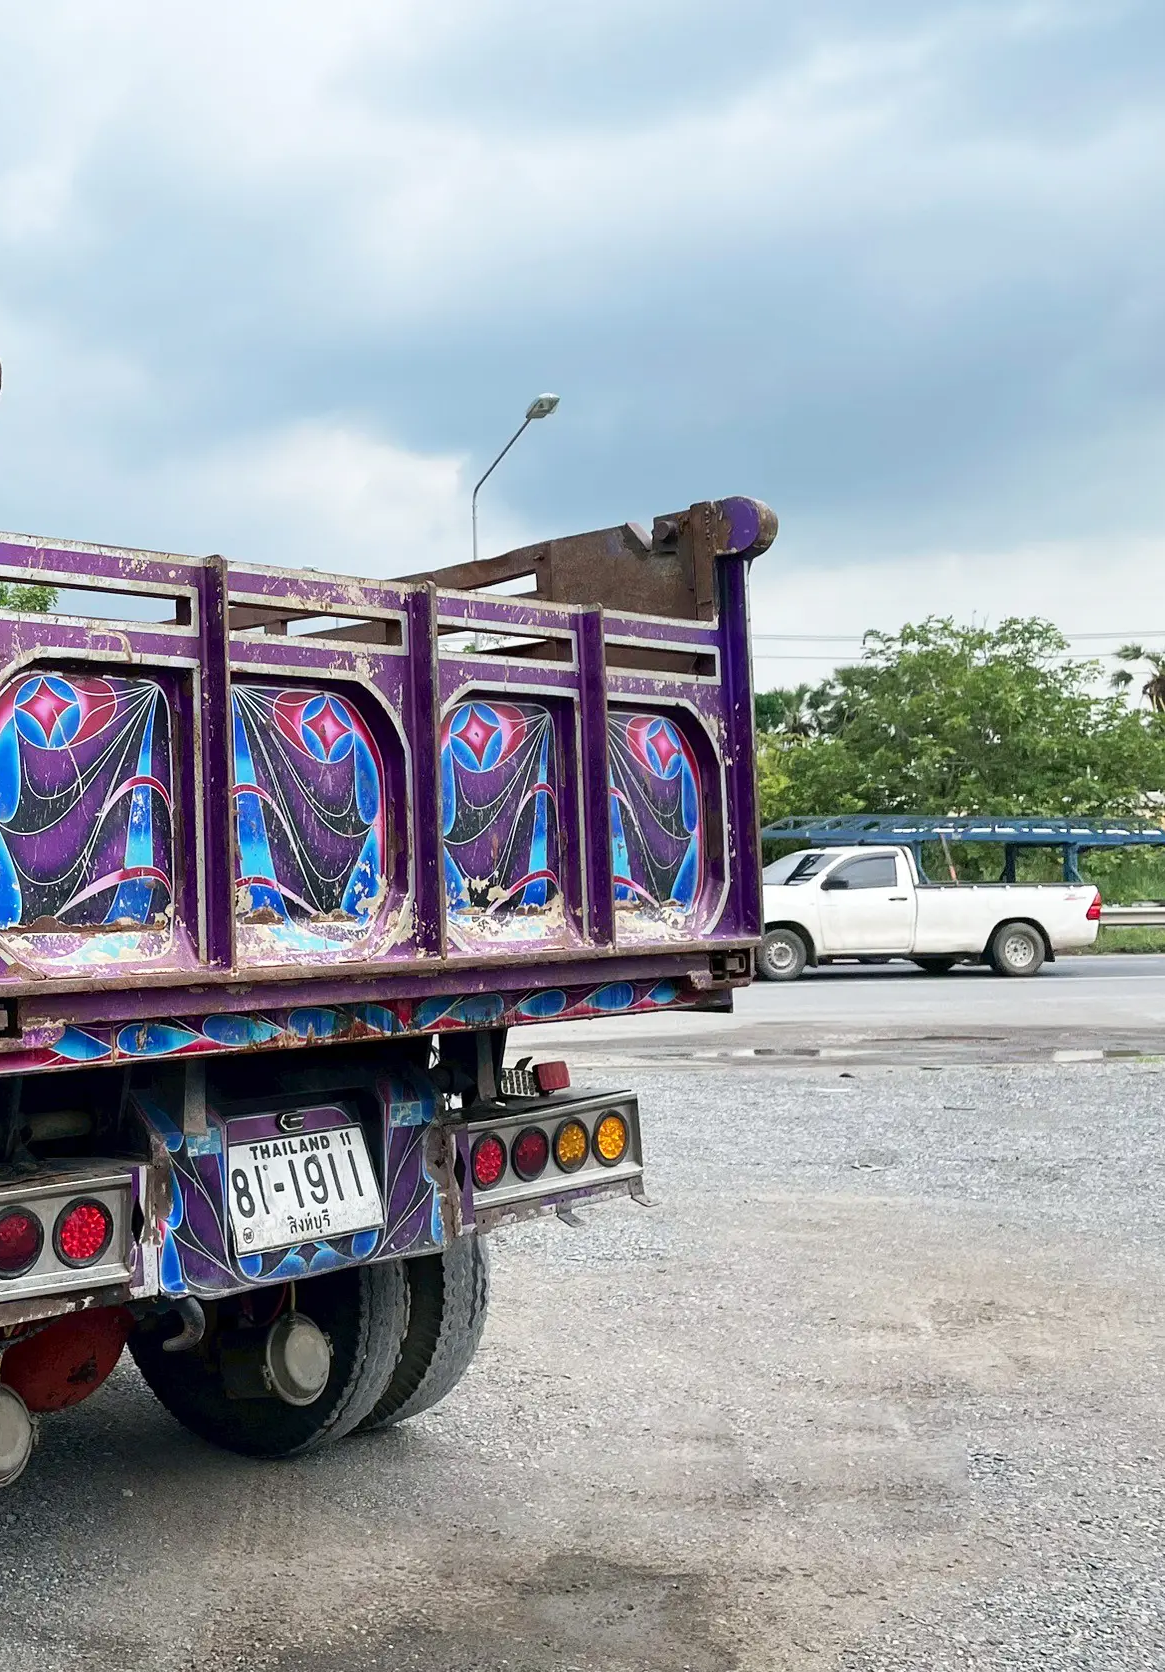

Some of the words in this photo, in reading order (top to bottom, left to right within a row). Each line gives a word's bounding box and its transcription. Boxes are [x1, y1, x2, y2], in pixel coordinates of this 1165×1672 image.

[250, 1135, 331, 1161] THAILAND
[231, 1149, 364, 1219] 81-1911
[287, 1208, 331, 1234] สิงห์บุรี
